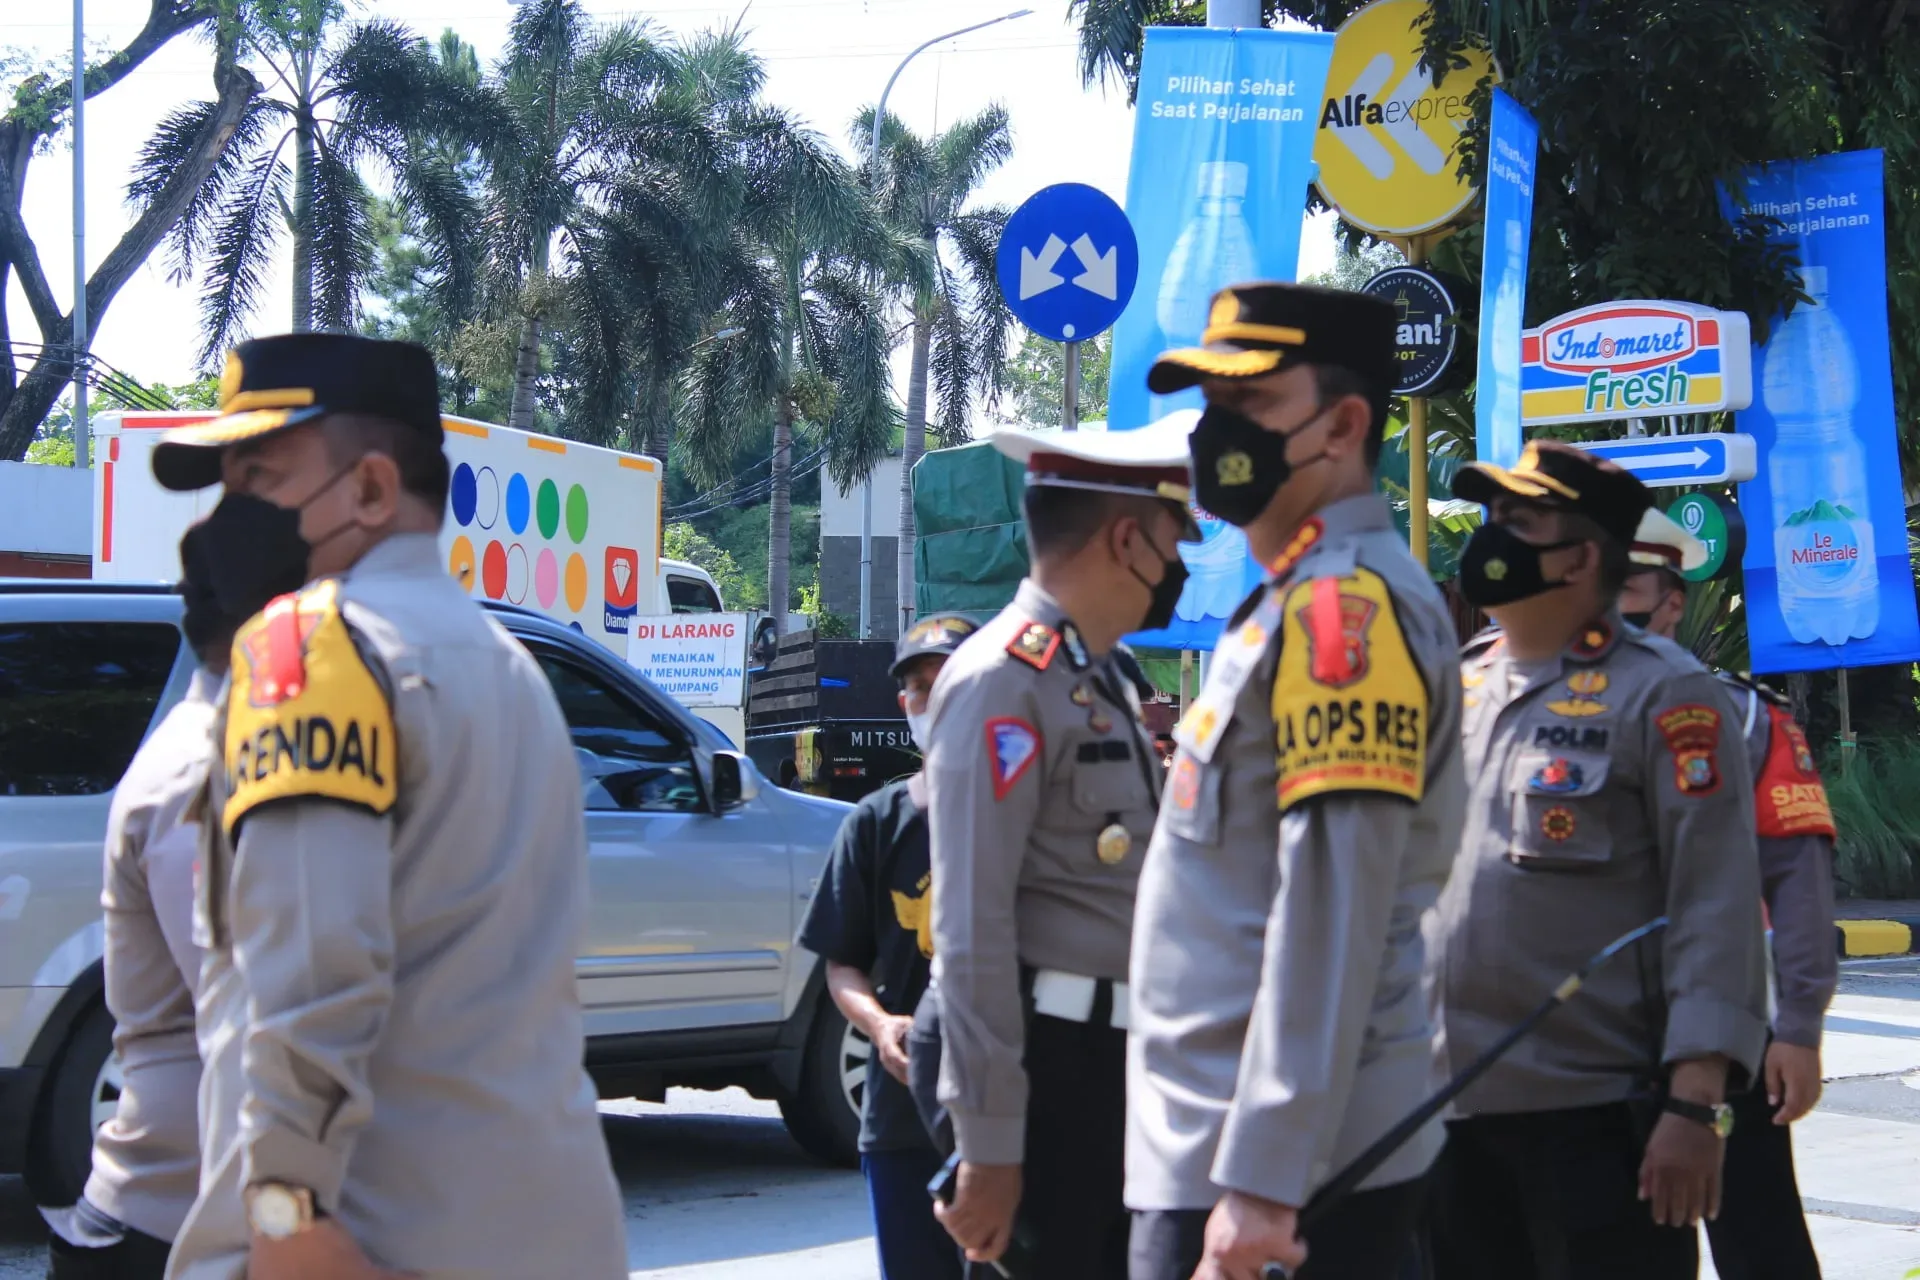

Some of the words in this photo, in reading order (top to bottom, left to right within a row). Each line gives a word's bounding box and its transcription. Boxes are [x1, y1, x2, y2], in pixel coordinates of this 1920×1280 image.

[1167, 76, 1234, 95] Pilihan
[1240, 79, 1296, 97] Sehat
[1151, 101, 1197, 119] Saat
[1203, 102, 1303, 124] Perjalanan
[1805, 192, 1858, 212] Sehat
[1395, 313, 1442, 345] an!
[1551, 321, 1685, 362] Indomaret
[1585, 364, 1688, 411] Fresh
[1814, 532, 1832, 549] Le
[1791, 544, 1858, 565] Minerale
[605, 612, 628, 629] Diamo
[638, 625, 655, 639] DI
[661, 623, 735, 639] LARANG
[650, 653, 715, 664] MENAIKAN
[655, 667, 742, 678] MENURUNKAN
[1305, 699, 1366, 748] OPS
[1375, 700, 1419, 753] RES
[851, 731, 910, 747] MITSU
